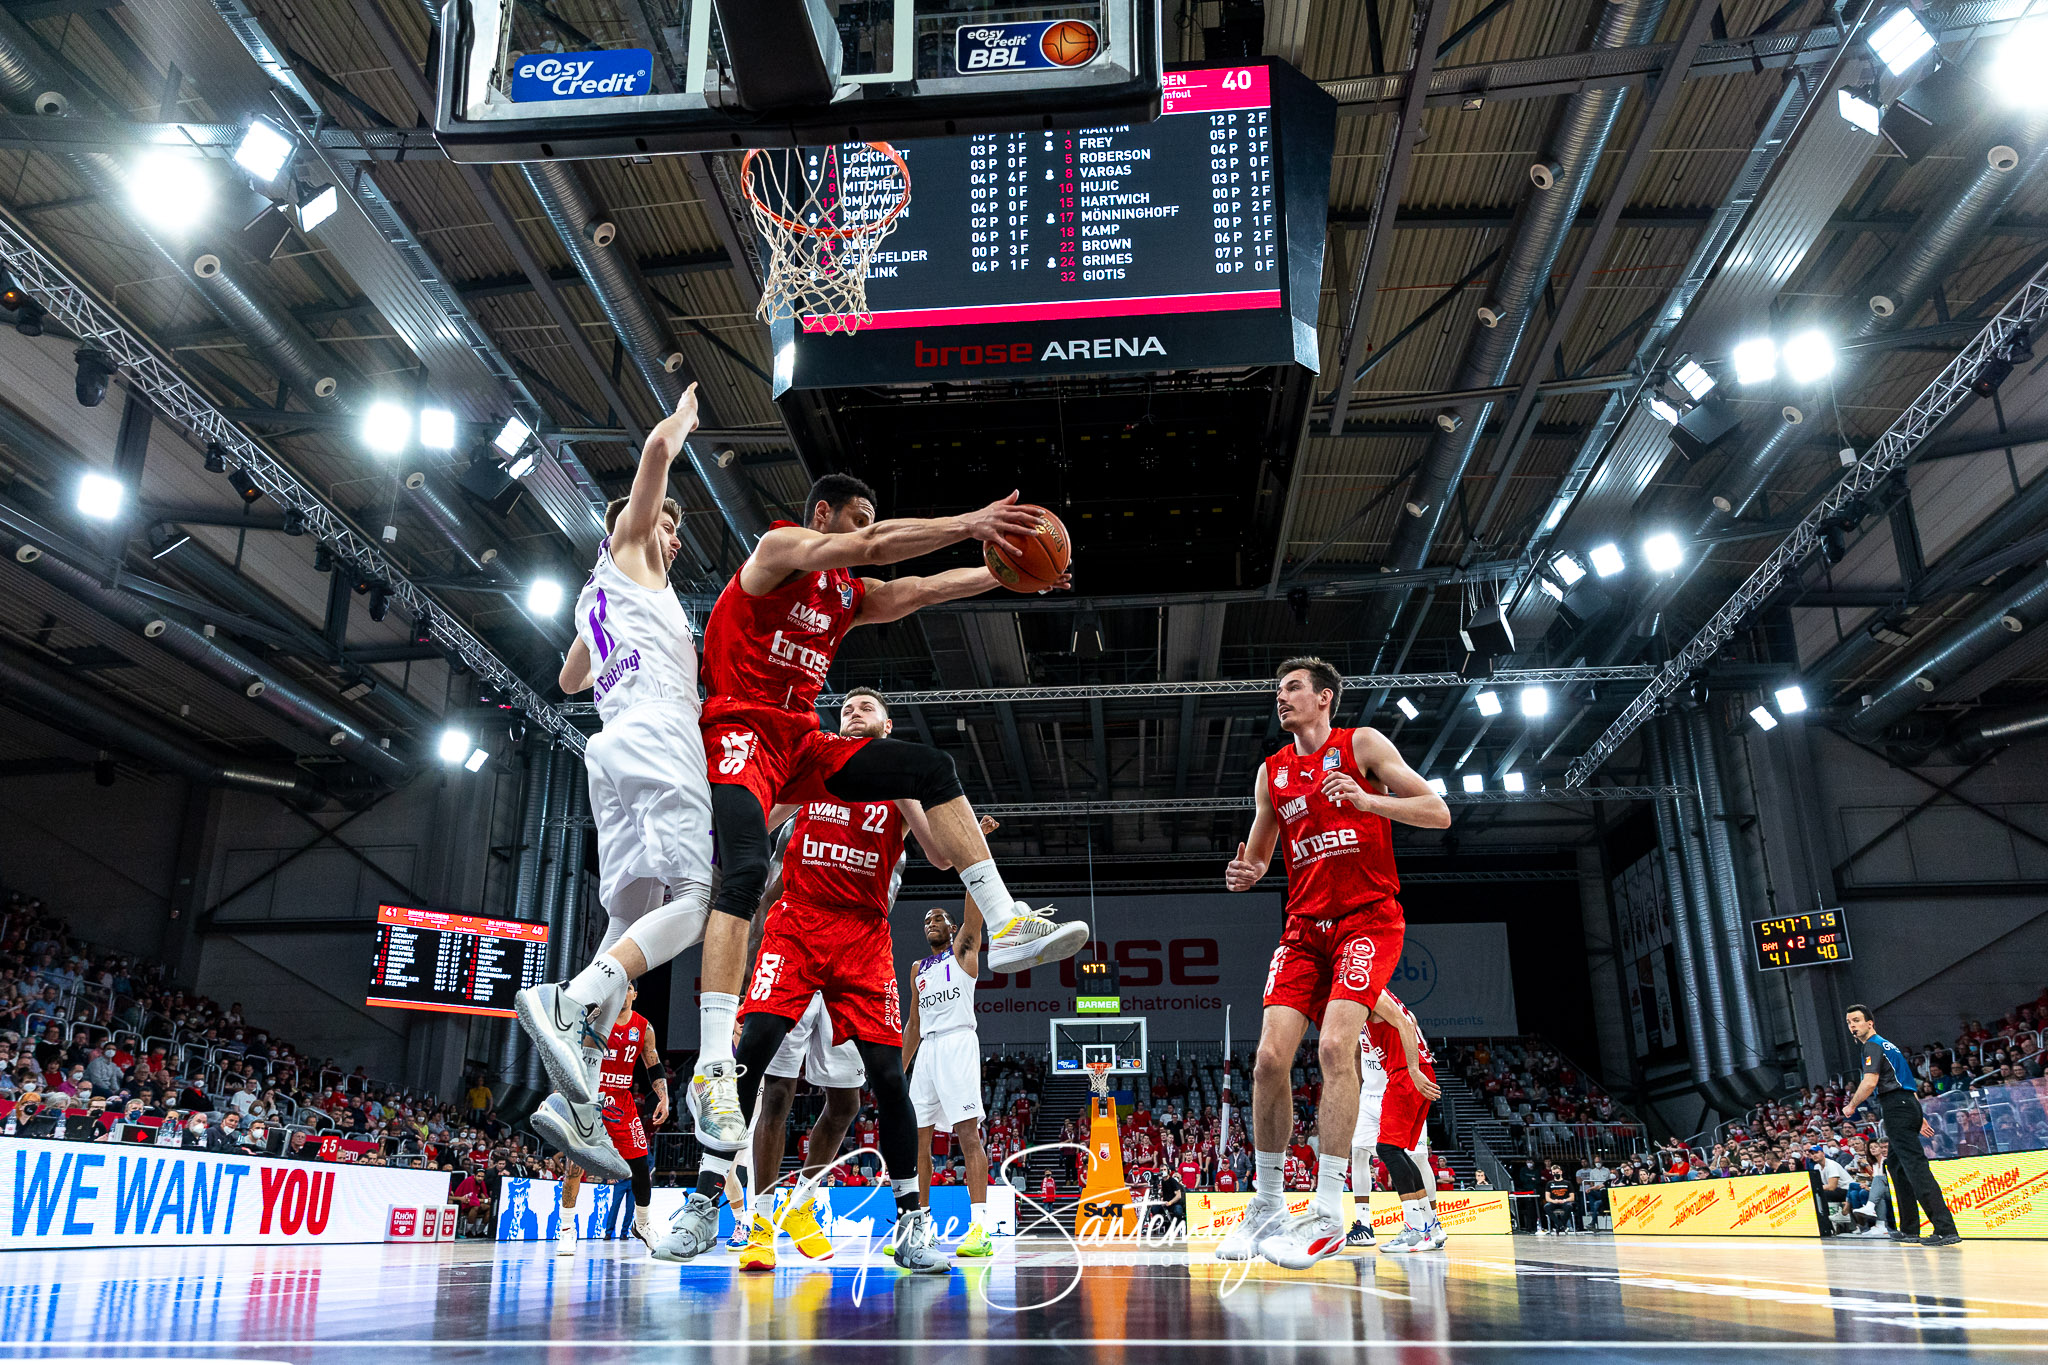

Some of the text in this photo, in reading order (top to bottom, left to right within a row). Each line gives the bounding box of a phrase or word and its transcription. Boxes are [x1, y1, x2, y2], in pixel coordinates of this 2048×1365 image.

[967, 47, 1026, 69] BBL
[1222, 70, 1252, 90] 40
[1166, 101, 1174, 110] 5
[1210, 115, 1225, 126] 12
[1228, 114, 1237, 125] P
[1248, 113, 1255, 123] 2
[1258, 112, 1267, 123] F
[1065, 126, 1267, 150] 3 FREY 05 P 0 F
[971, 145, 985, 156] 03
[989, 144, 997, 155] P
[1008, 143, 1015, 153] 3
[1018, 142, 1026, 153] F
[1065, 141, 1268, 164] 5 ROBERSON 04 P 3 F
[971, 159, 986, 170] 03
[989, 159, 997, 169] P
[1008, 157, 1016, 168] 0
[1019, 157, 1027, 167] F
[1065, 155, 1269, 178] 8 VARGAS 03 P 0 F
[971, 174, 986, 185] 04
[989, 173, 998, 184] P
[1008, 172, 1016, 182] 4
[1019, 171, 1027, 182] F
[1059, 170, 1270, 193] 10 HUJIC 03 P 1 F
[971, 188, 986, 199] 00
[989, 187, 998, 198] P
[1008, 186, 1016, 197] 0
[1019, 186, 1028, 196] F
[1059, 185, 1270, 208] 15 HARTWICH 00 P 2 F
[1060, 200, 1271, 222] 17 MÖNNINGHOFF 00 P 2 F
[1060, 215, 1272, 237] 18 KAMP 00 P 1 F
[1060, 229, 1273, 252] 22 BROWN 06 P 2 F
[1060, 244, 1273, 267] 24 GRIMES 07 P 1 F
[1061, 259, 1274, 281] 32 GIOTIS 00 P 0 F
[915, 336, 1168, 367] brose ARENA
[808, 803, 888, 834] LVM 22
[803, 833, 879, 869] brose
[802, 858, 831, 868] Excellence
[1762, 934, 1835, 951] BAM 2 GOT
[1770, 944, 1838, 965] 41 40
[751, 952, 781, 1001] SIXT
[945, 964, 951, 981] 1
[973, 997, 1062, 1014] xcellence
[1078, 1000, 1119, 1010] BARMER
[624, 1045, 637, 1062] 12
[600, 1072, 633, 1085] rose
[12, 1150, 335, 1237] WE WANT YOU
[394, 1210, 415, 1220] RHÖN
